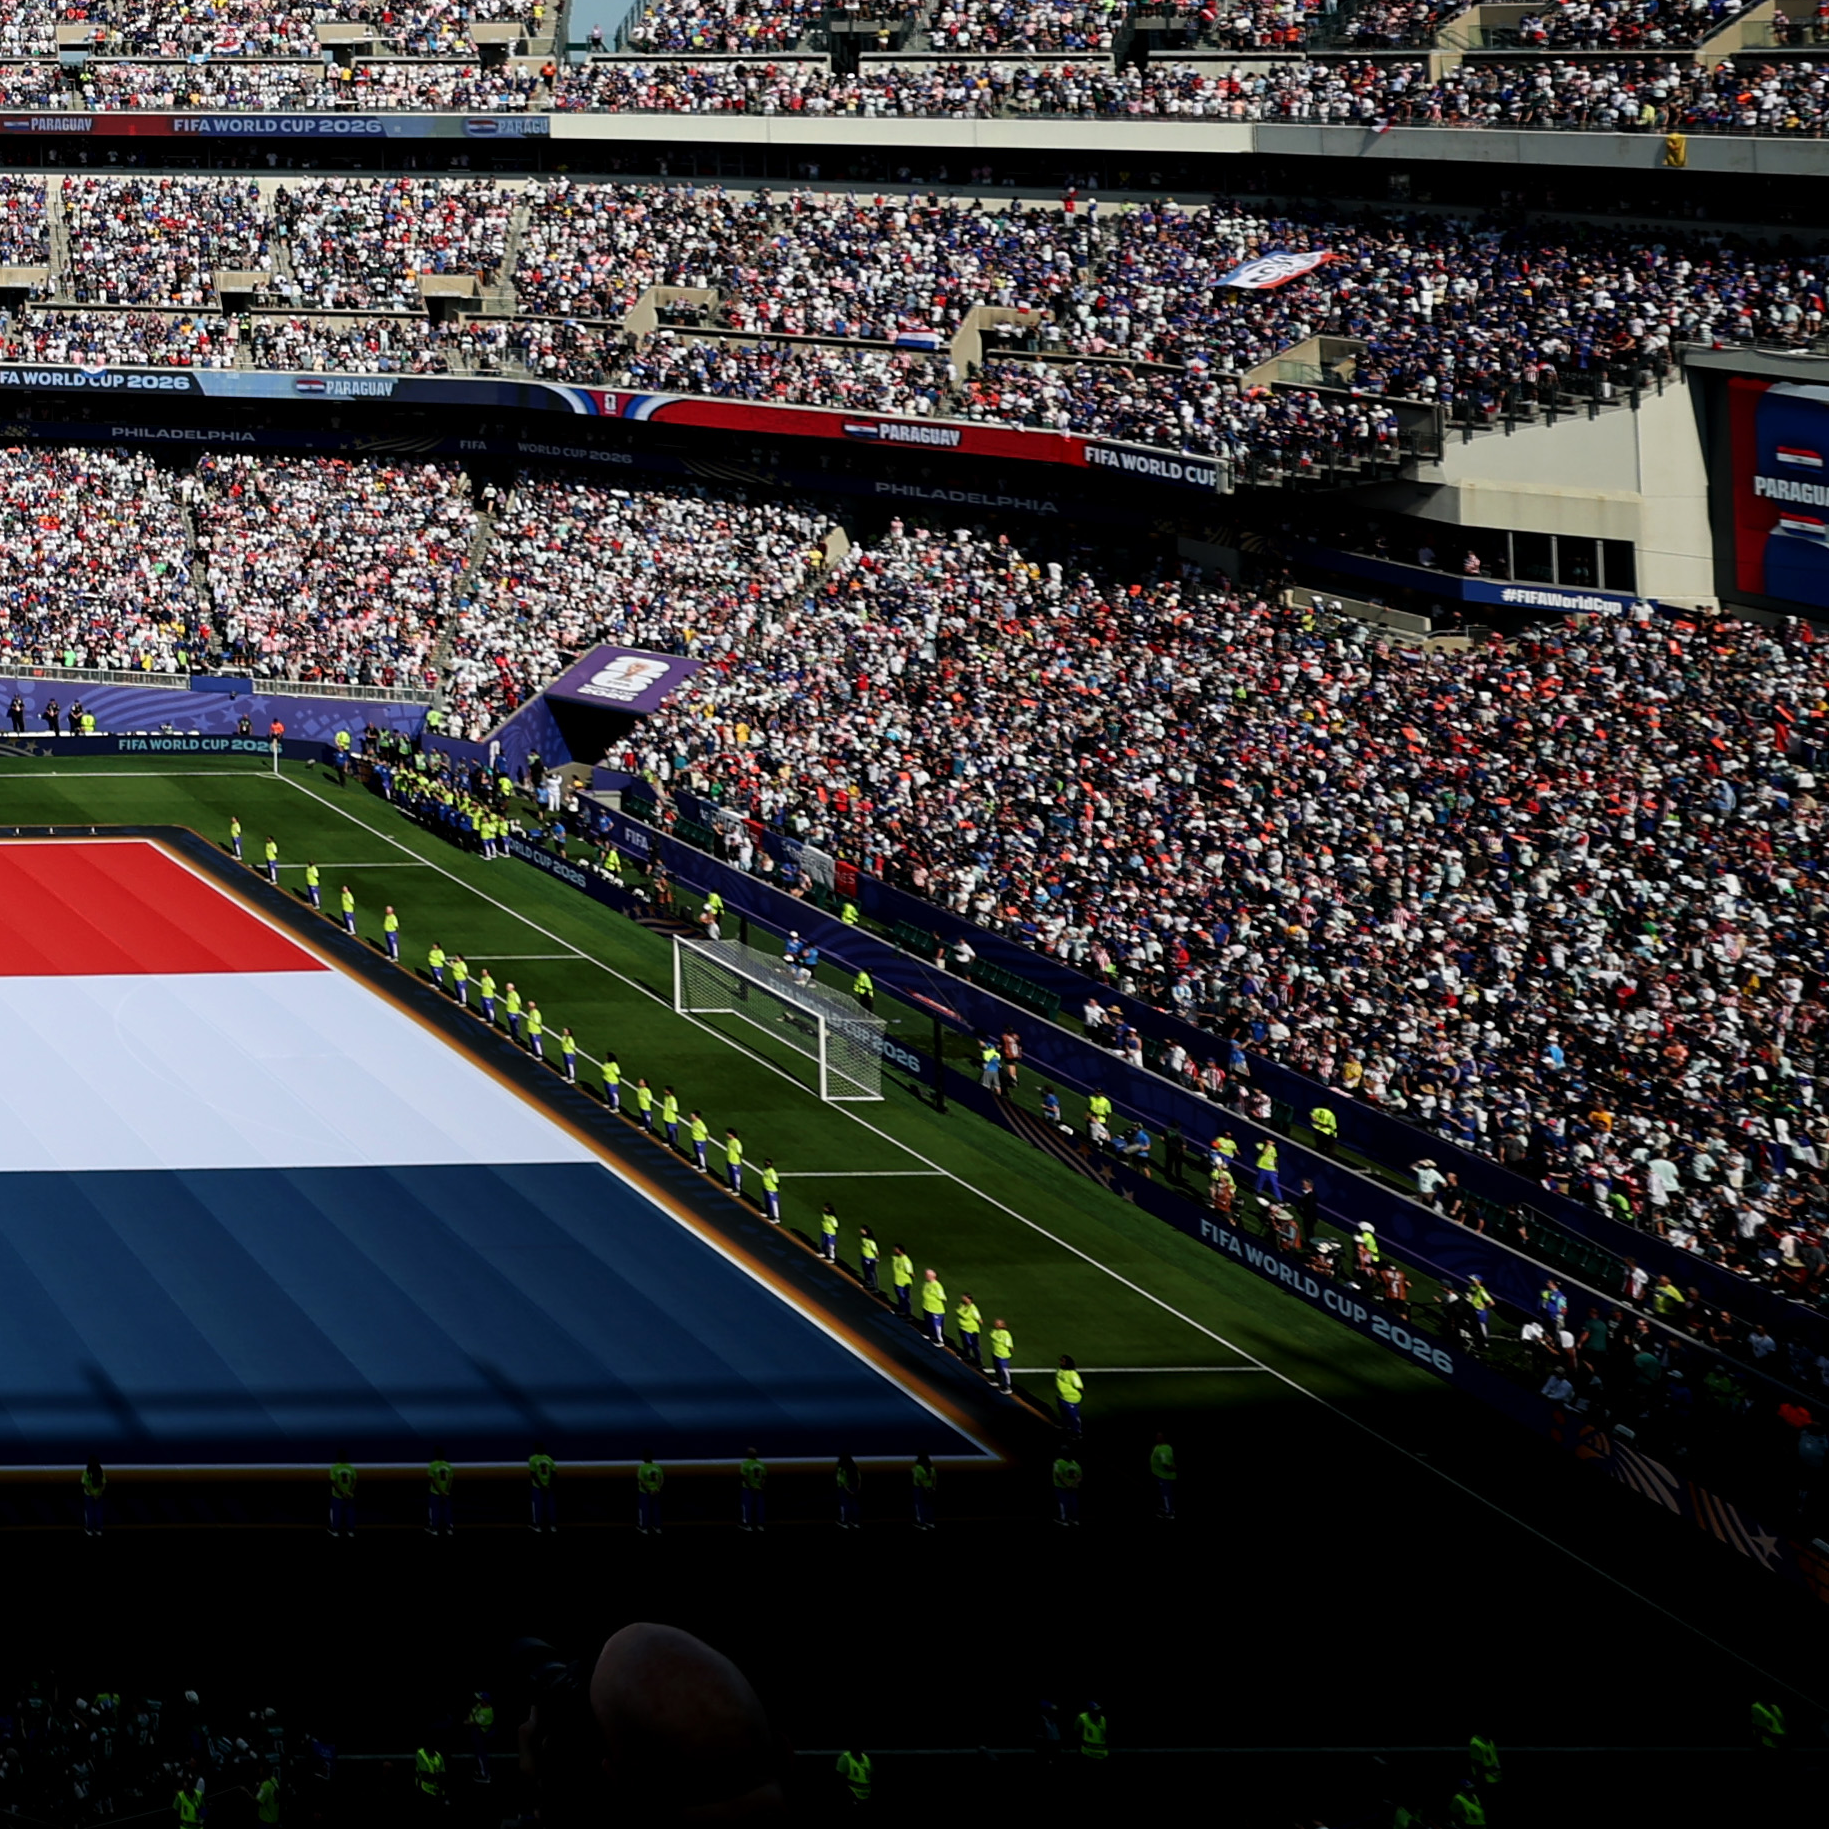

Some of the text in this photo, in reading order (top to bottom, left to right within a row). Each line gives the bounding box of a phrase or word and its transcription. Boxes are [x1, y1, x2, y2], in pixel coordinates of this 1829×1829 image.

[30, 117, 93, 131] PARAGUAY
[173, 118, 383, 133] FIFA WORLD CUP 2026
[22, 371, 85, 388] WORLD
[126, 375, 190, 390] 2026
[325, 380, 393, 397] PARAGUAY
[111, 426, 256, 442] PHILADELPHIA
[878, 422, 960, 447] PARAGUAY
[459, 439, 634, 465] FIFA WORLD CUP 2026
[1083, 446, 1120, 467] FIFA
[1120, 451, 1183, 478] WORLD
[874, 481, 1059, 513] PHILADELPHIA
[1753, 475, 1829, 508] PARAGU
[1501, 588, 1623, 615] #FIFAWorldCup
[118, 739, 148, 751] FIFA
[149, 739, 199, 750] WORLD
[201, 739, 229, 750] CUP
[624, 826, 649, 851] FIFA
[533, 849, 586, 888] CUP 2026
[871, 1036, 921, 1073] 2026
[1198, 1217, 1455, 1376] FIFA WORLD CUP 2026
